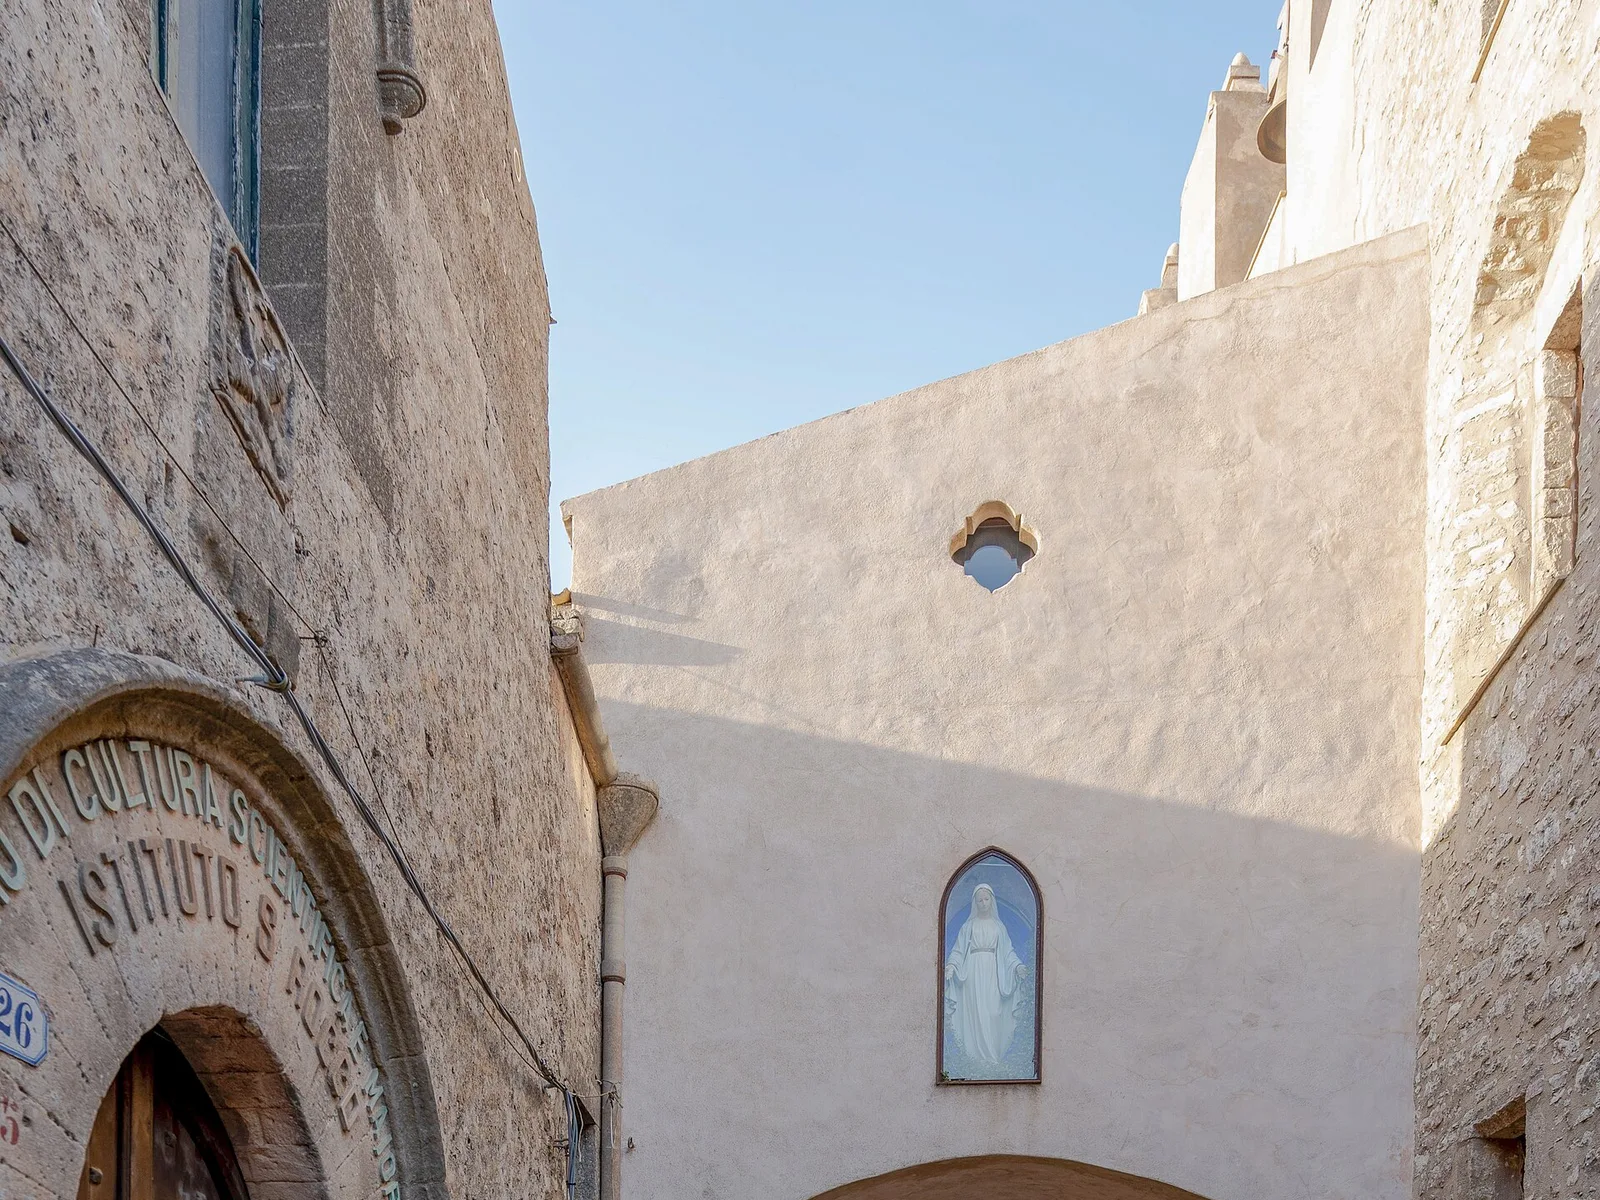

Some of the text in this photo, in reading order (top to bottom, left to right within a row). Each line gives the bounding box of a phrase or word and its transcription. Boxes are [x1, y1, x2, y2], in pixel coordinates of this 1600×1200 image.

[8, 765, 71, 859] DI
[63, 739, 224, 828] CULTURA
[229, 788, 352, 1035] SCIENTIFICA
[57, 837, 242, 957] ISTITUTO
[285, 946, 361, 1133] ROCCO
